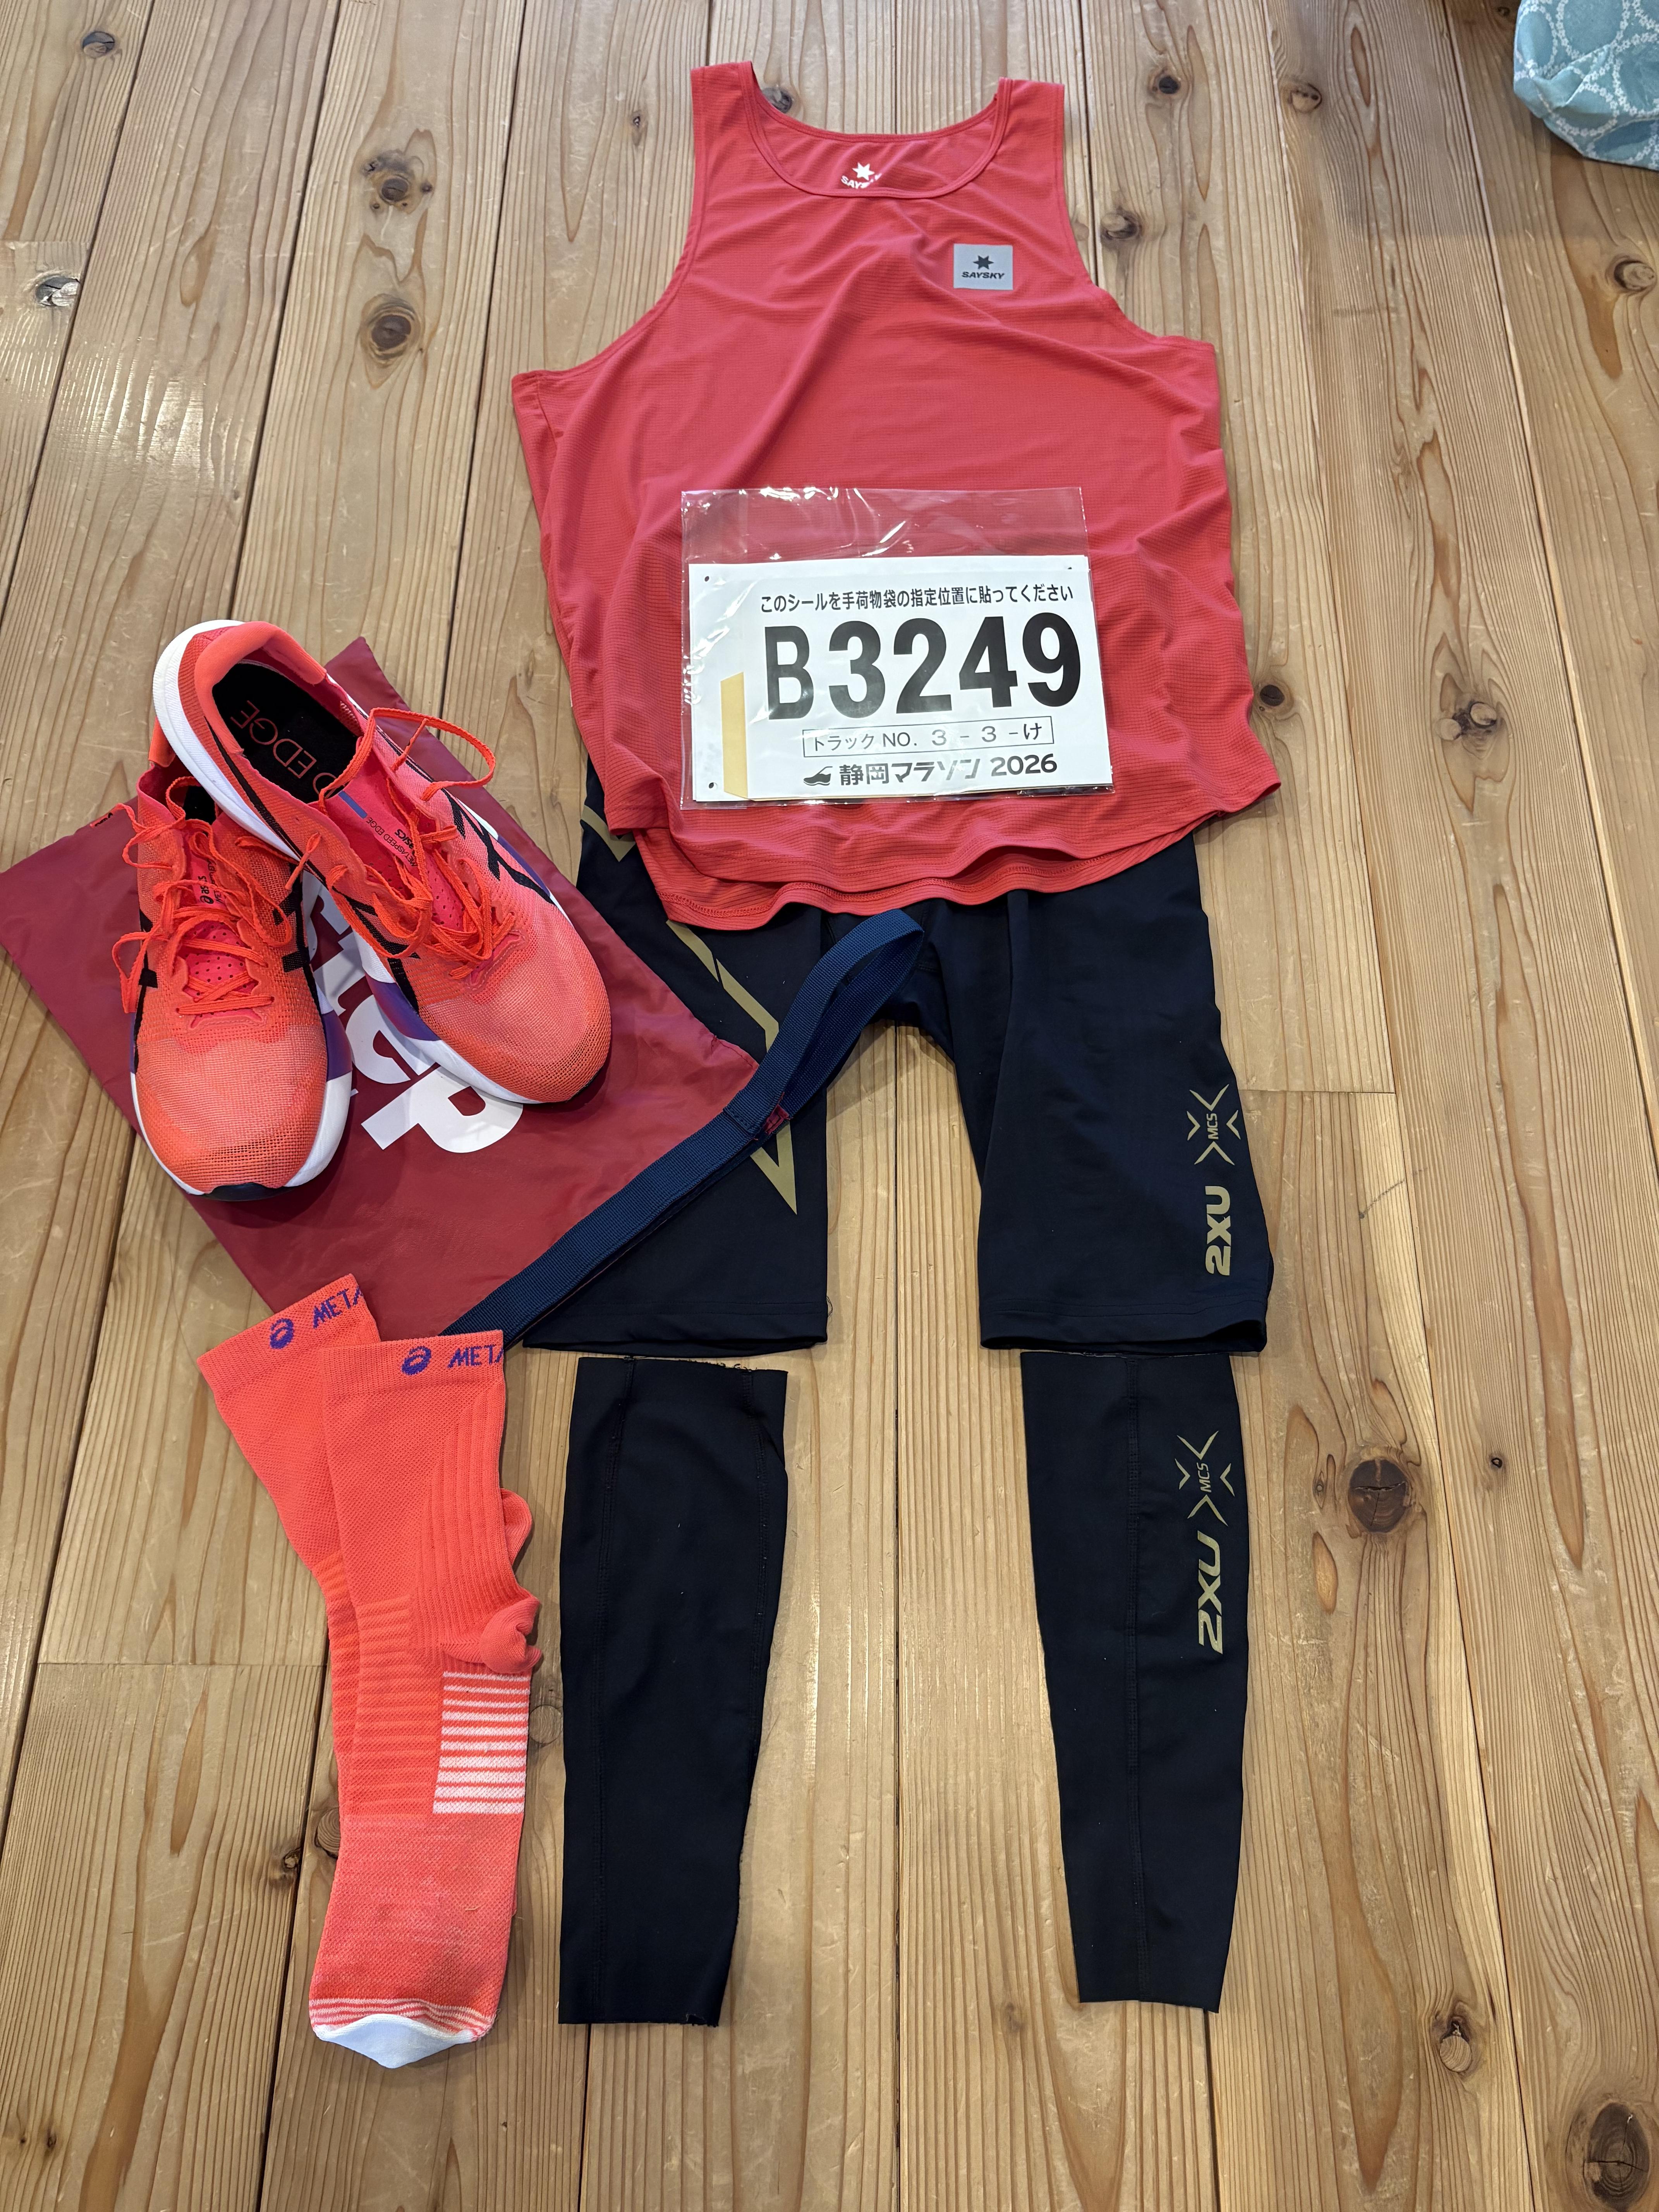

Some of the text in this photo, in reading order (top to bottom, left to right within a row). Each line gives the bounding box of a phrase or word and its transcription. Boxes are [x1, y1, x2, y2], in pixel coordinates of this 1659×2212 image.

[761, 583, 1073, 613] このシールを手荷物袋の指定位置に貼ってください
[764, 612, 1081, 720] B3249
[230, 700, 317, 779] EDGE
[815, 733, 874, 752] トラック
[882, 732, 917, 748] NO.
[839, 753, 1058, 786] 静岡マラソン 2026
[366, 817, 417, 867] METASPEED EDGE
[1206, 1113, 1219, 1140] MCS
[1205, 1186, 1231, 1276] 2XU
[1197, 1462, 1212, 1493] MCS
[1197, 1530, 1223, 1654] 2XU
